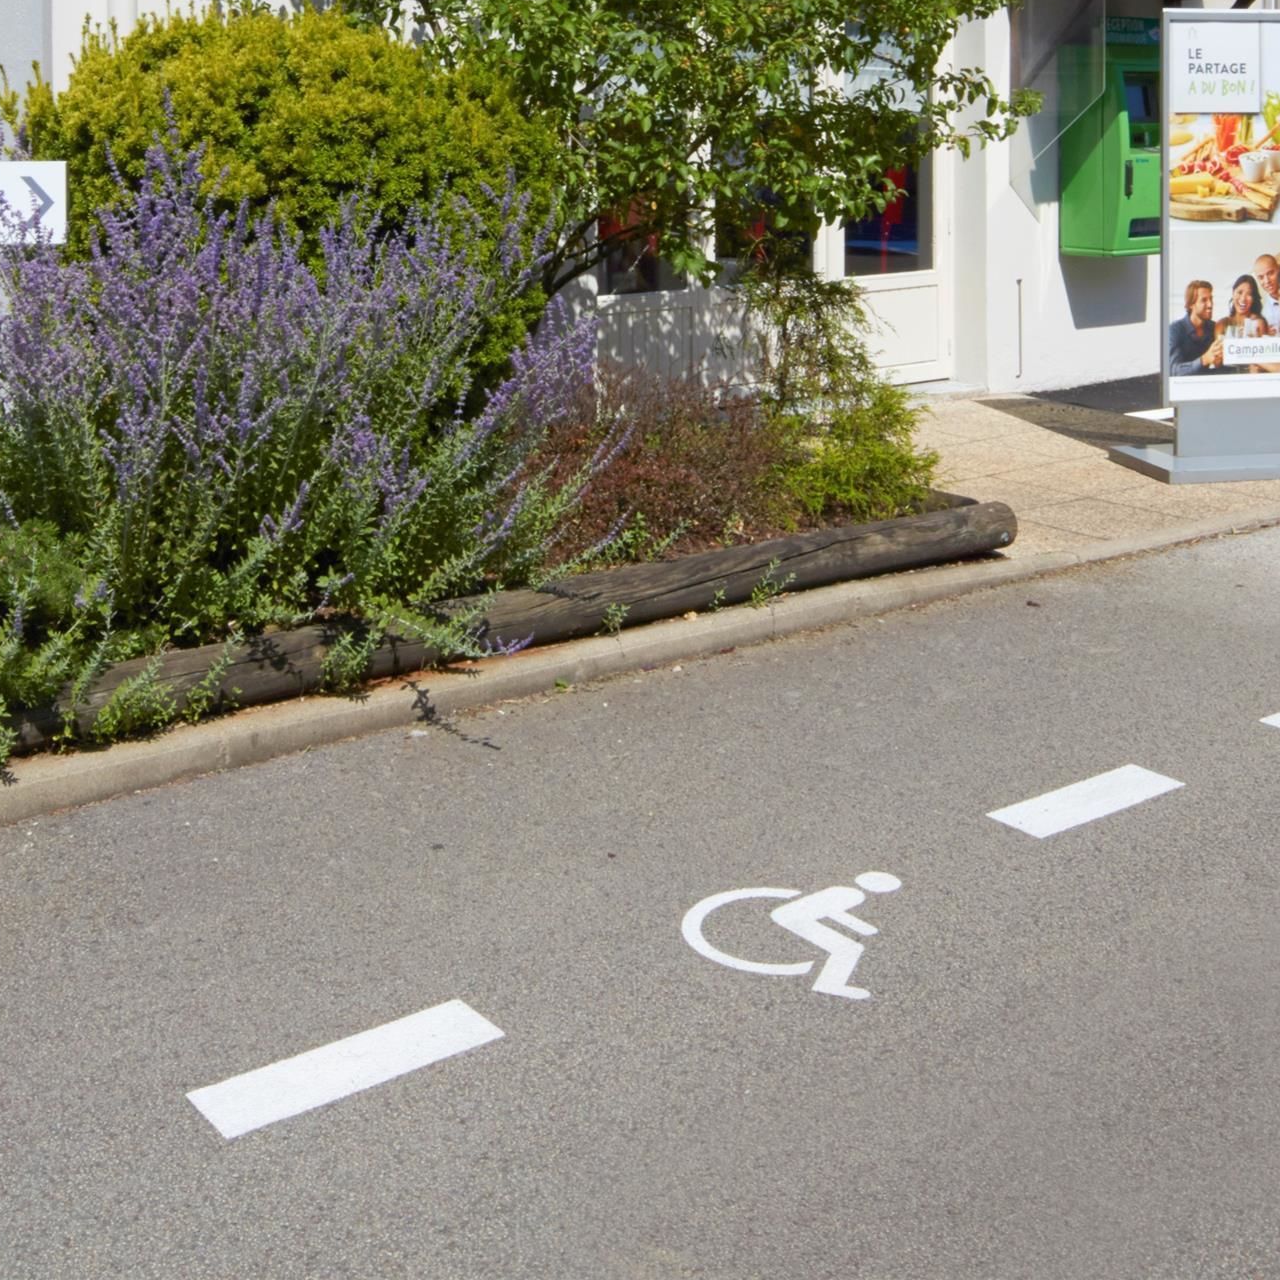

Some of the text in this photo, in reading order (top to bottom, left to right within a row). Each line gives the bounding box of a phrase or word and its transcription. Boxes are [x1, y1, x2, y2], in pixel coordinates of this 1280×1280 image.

[1188, 48, 1203, 60] LE
[1188, 63, 1247, 74] PARTAGE
[1201, 80, 1216, 95] DU
